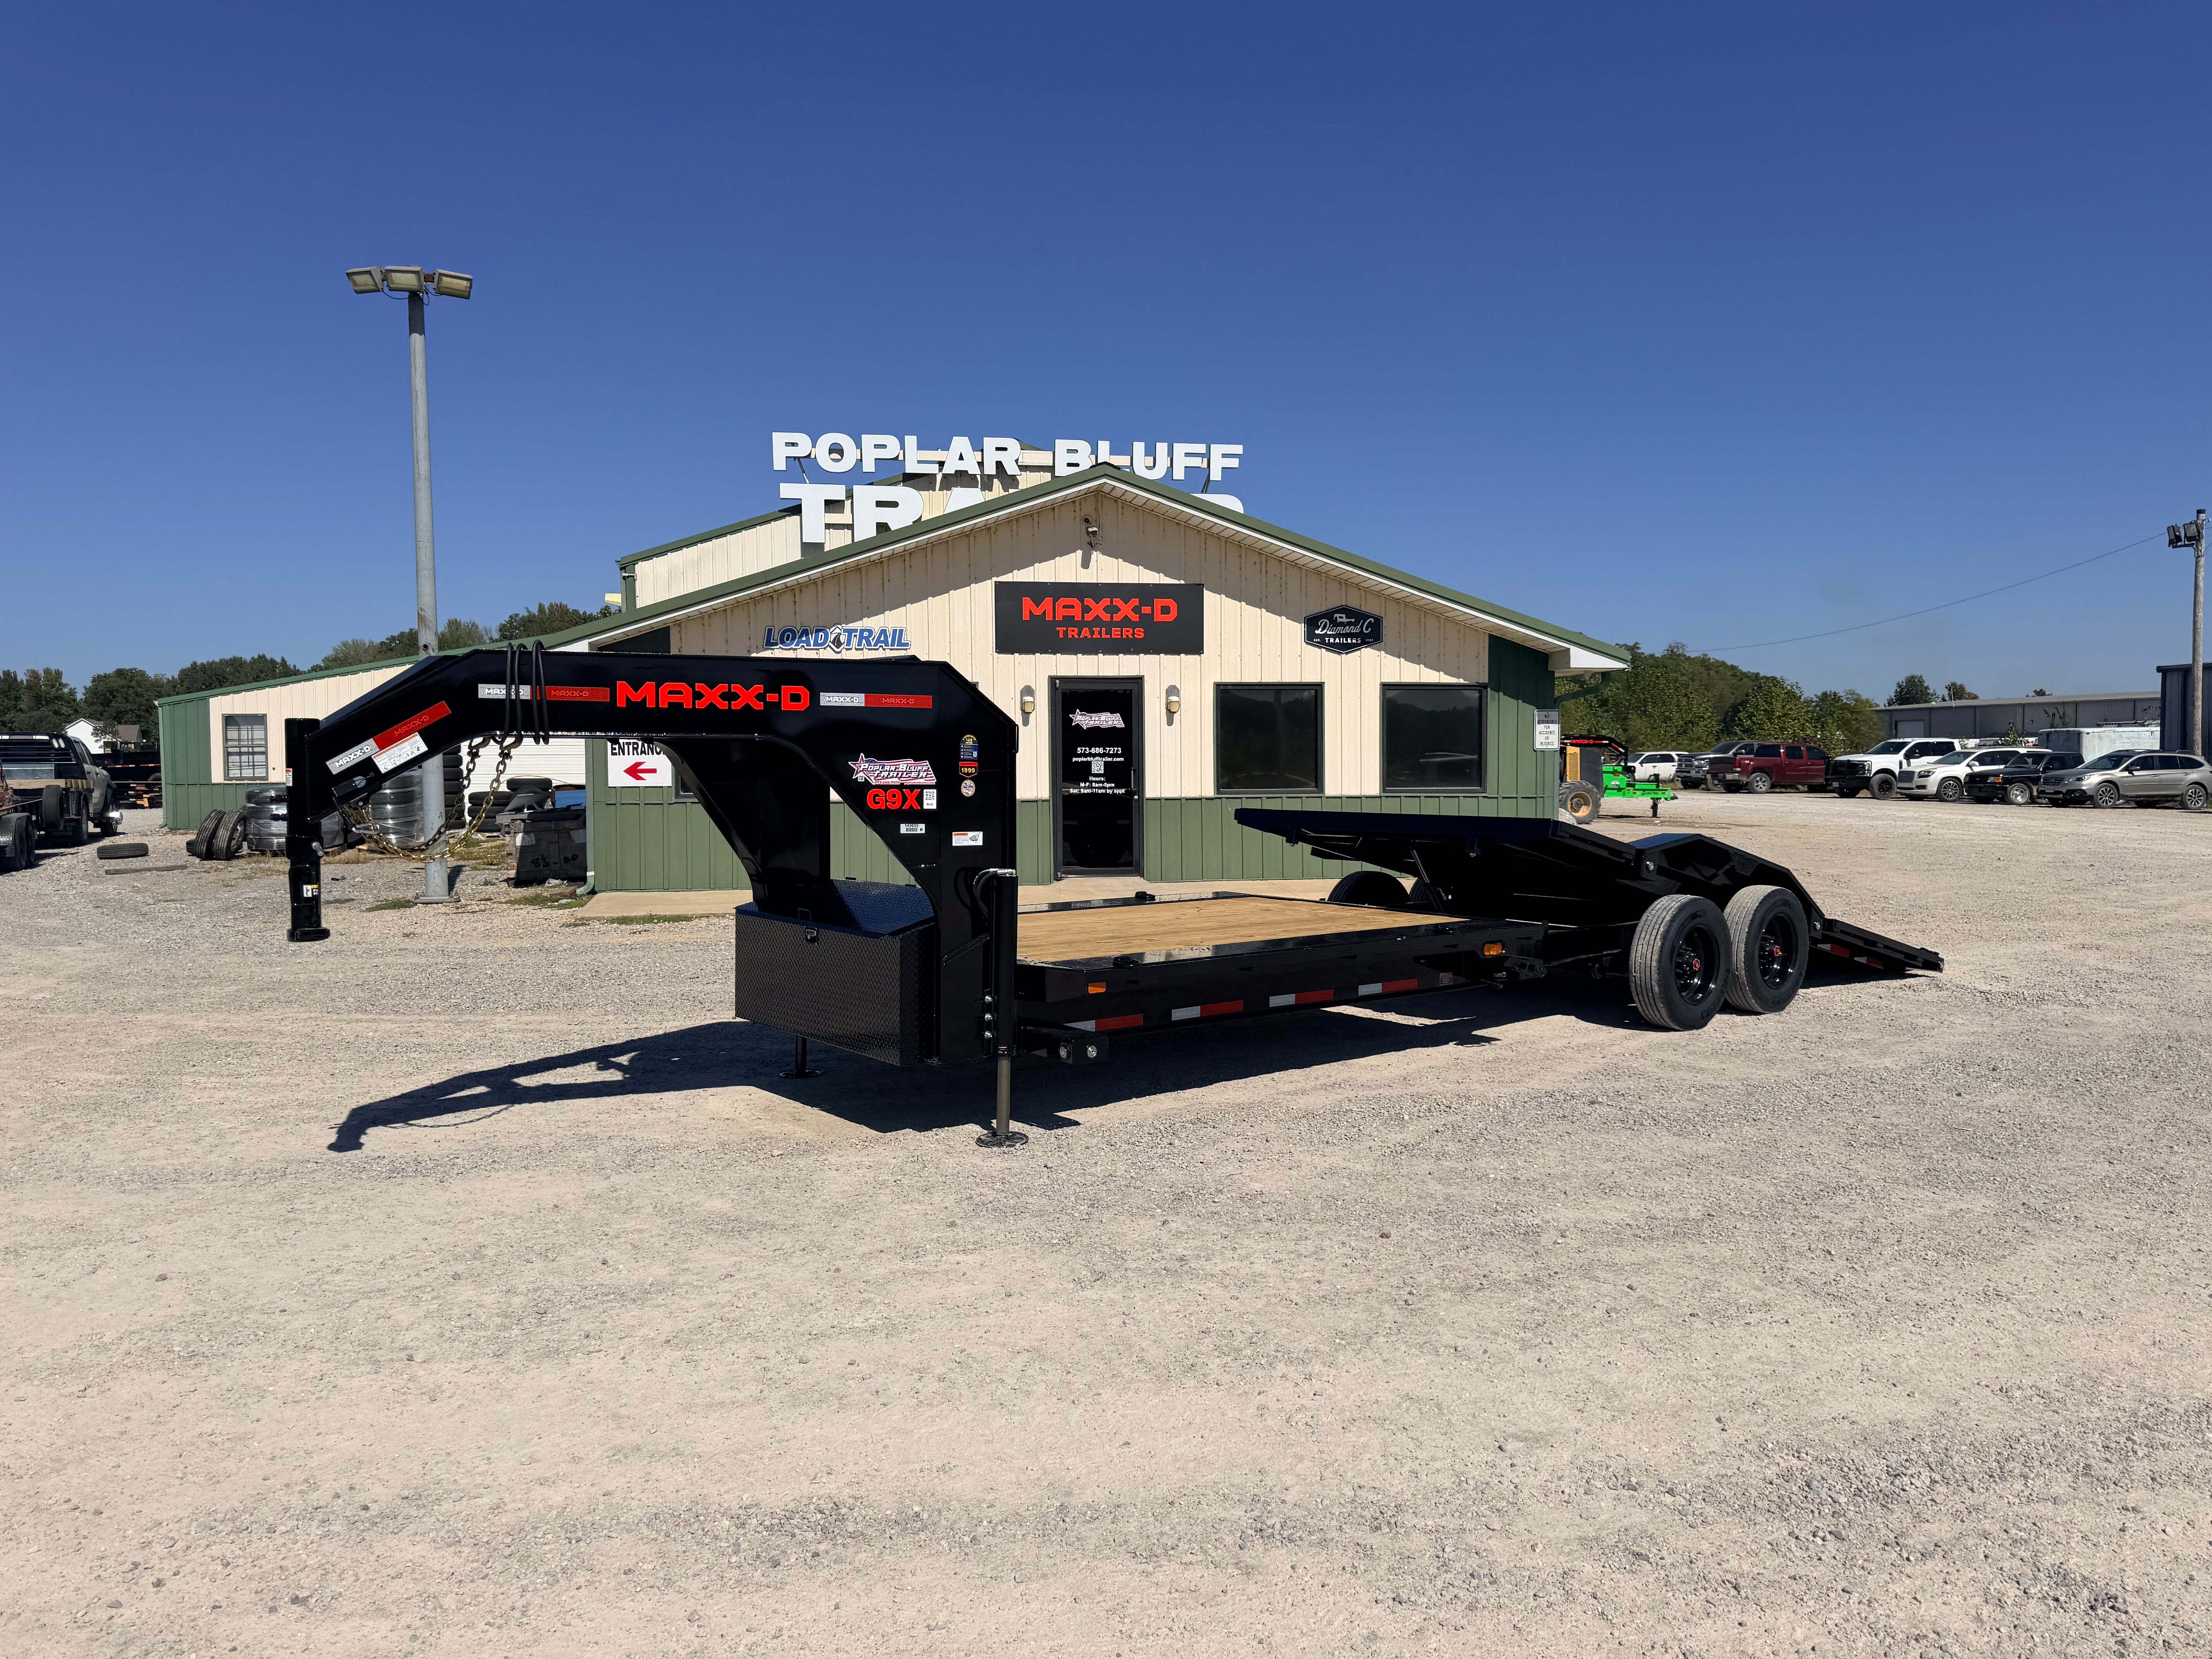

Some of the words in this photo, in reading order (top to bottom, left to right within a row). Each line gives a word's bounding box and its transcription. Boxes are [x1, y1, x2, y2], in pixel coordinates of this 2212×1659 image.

[772, 432, 1022, 475] POPLAR
[1054, 439, 1243, 481] BLUFF
[1022, 597, 1178, 622] MAXX-D
[1056, 627, 1145, 639] TRAILERS
[1315, 619, 1363, 634] Diamond
[1363, 618, 1374, 633] C
[764, 627, 830, 648] LOAD
[843, 627, 911, 648] TRAIL
[617, 681, 809, 711] MAXX-D
[393, 715, 429, 736] MAXX-D
[334, 745, 371, 768] MAXX-D
[867, 789, 921, 809] G9X
